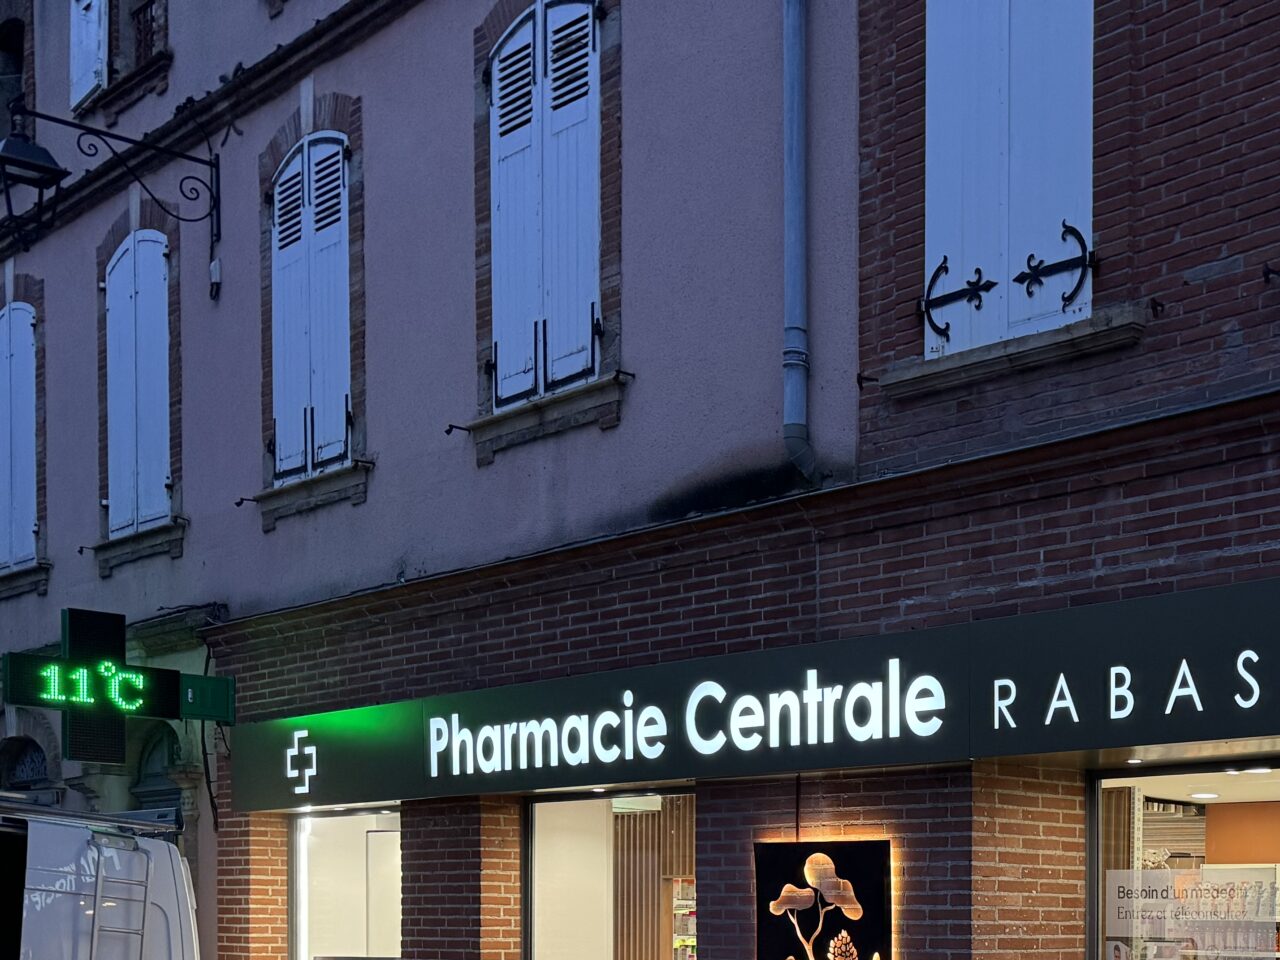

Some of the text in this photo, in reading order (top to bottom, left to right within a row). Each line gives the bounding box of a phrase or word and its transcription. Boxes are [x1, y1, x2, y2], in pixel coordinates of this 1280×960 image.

[40, 661, 144, 710] 11°C
[430, 658, 946, 777] Pharmacie Centrale
[1117, 885, 1158, 899] Besoin
[1161, 885, 1189, 899] d'un
[1117, 906, 1153, 920] Entrez
[1156, 907, 1167, 920] et
